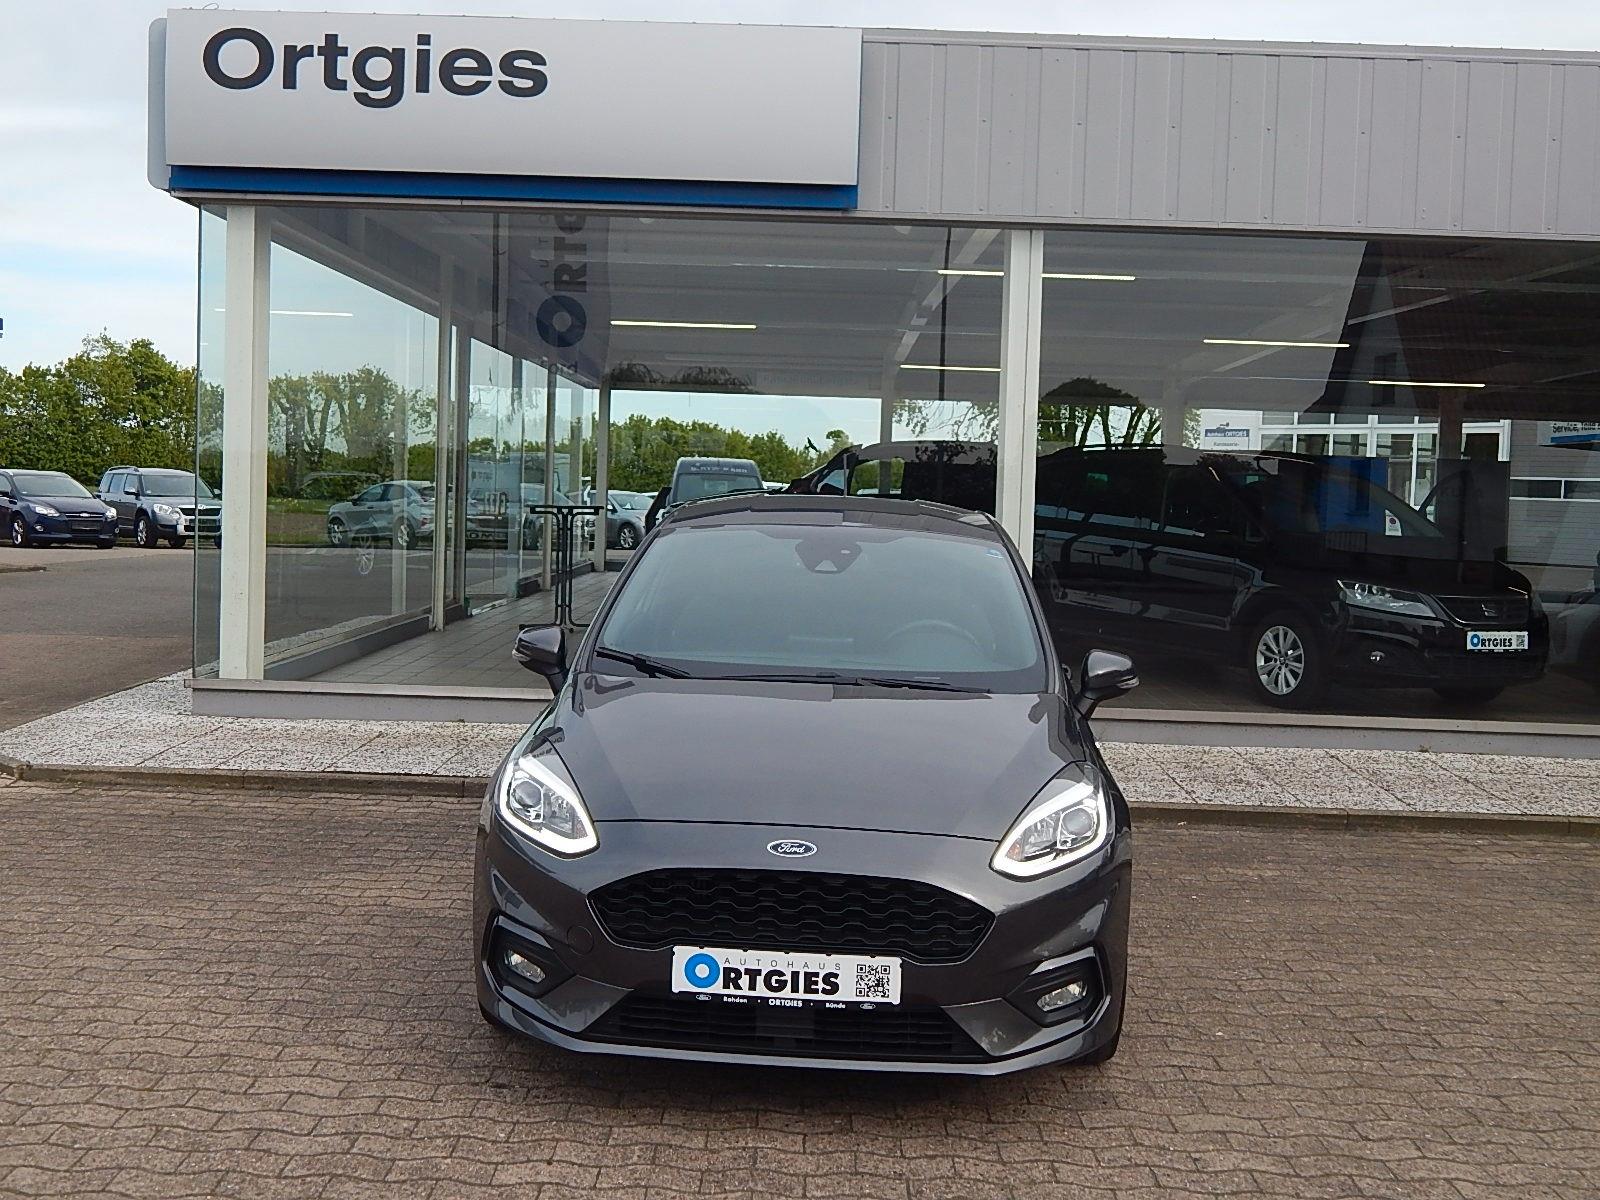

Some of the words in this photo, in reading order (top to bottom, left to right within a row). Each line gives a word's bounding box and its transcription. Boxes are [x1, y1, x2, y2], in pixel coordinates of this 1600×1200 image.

[203, 28, 548, 109] Ortgies
[1470, 634, 1513, 648] ORTGIES
[777, 843, 806, 853] Ford
[724, 957, 841, 971] AUTOHAUS
[684, 953, 840, 996] ORTGIES
[768, 998, 803, 1008] ORTGIES
